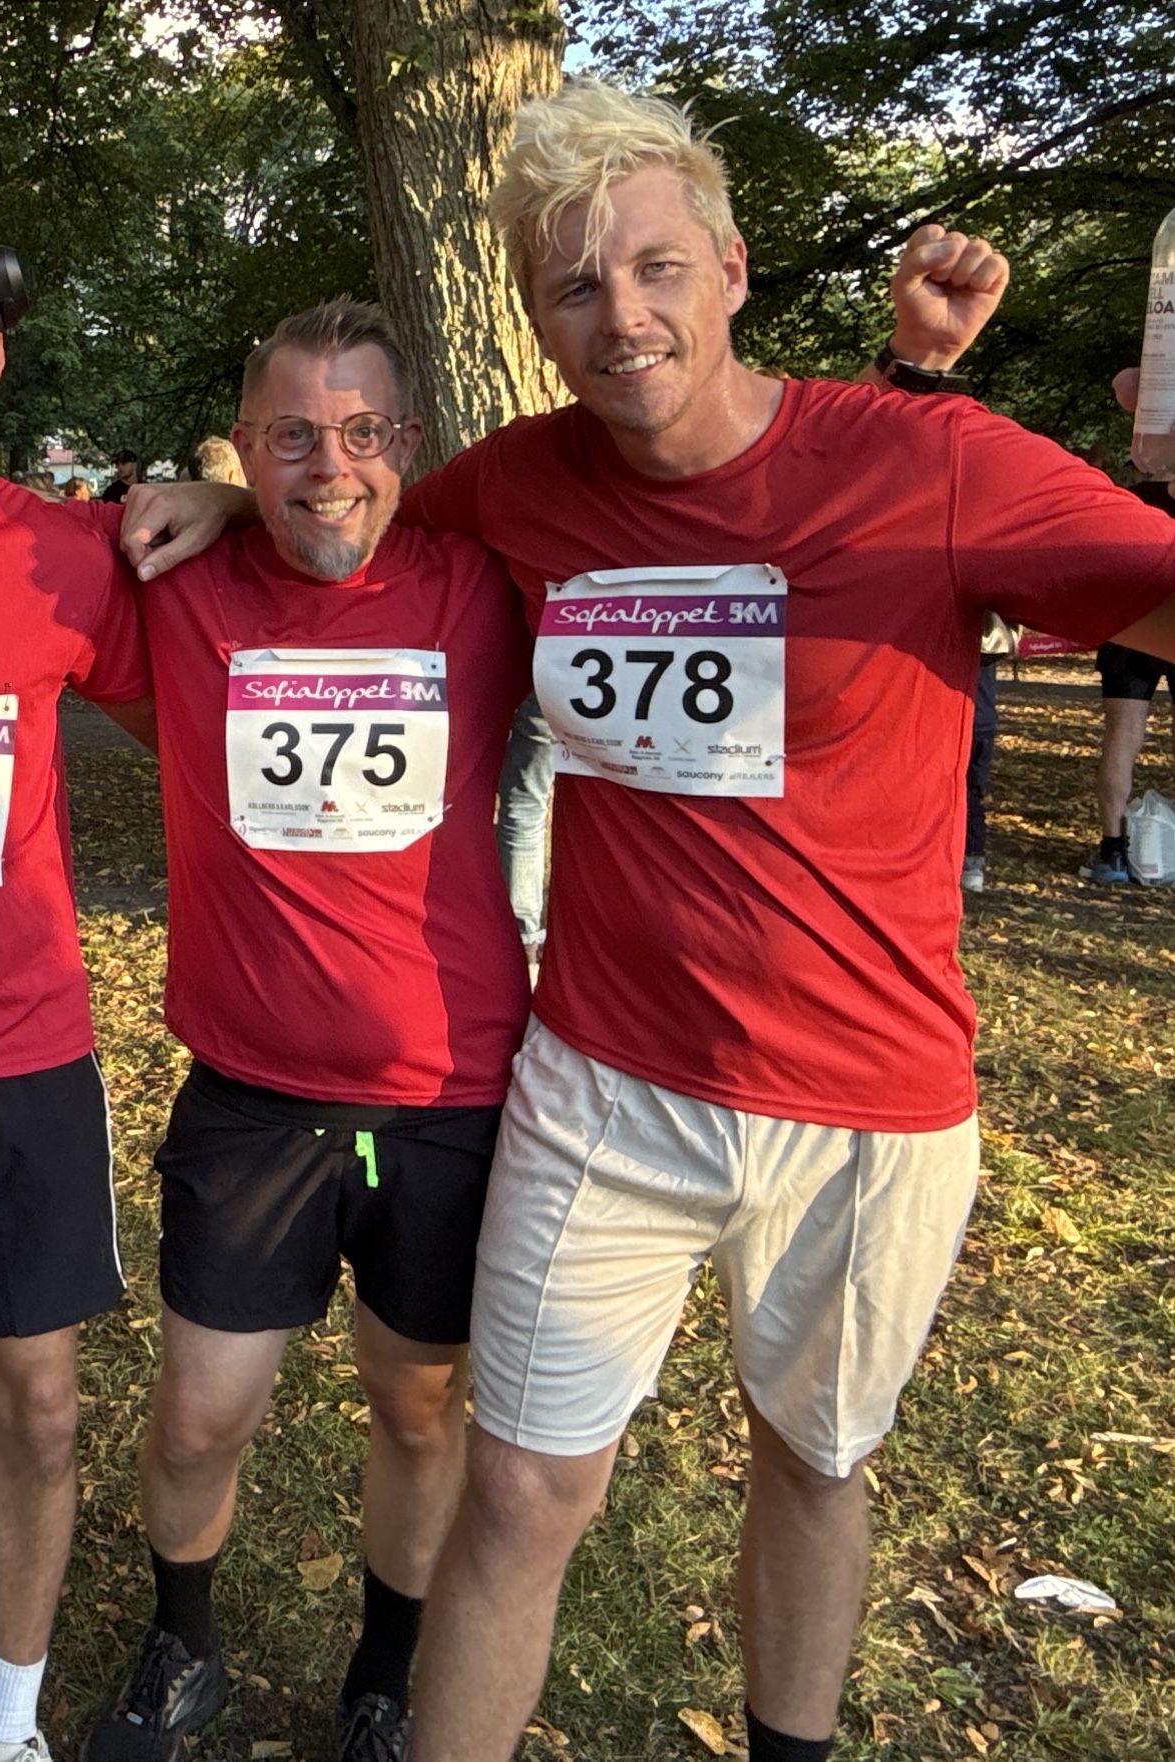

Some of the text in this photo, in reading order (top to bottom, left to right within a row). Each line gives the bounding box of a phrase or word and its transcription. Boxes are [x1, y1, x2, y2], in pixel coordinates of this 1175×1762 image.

[554, 598, 778, 634] Sofialoppet 5KM
[241, 677, 442, 708] Sofialoppet 5KM
[569, 648, 734, 724] 378
[260, 721, 407, 787] 375
[707, 744, 762, 755] stadium
[676, 770, 724, 781] saucony
[381, 803, 425, 814] stadium
[358, 828, 396, 837] saucony
